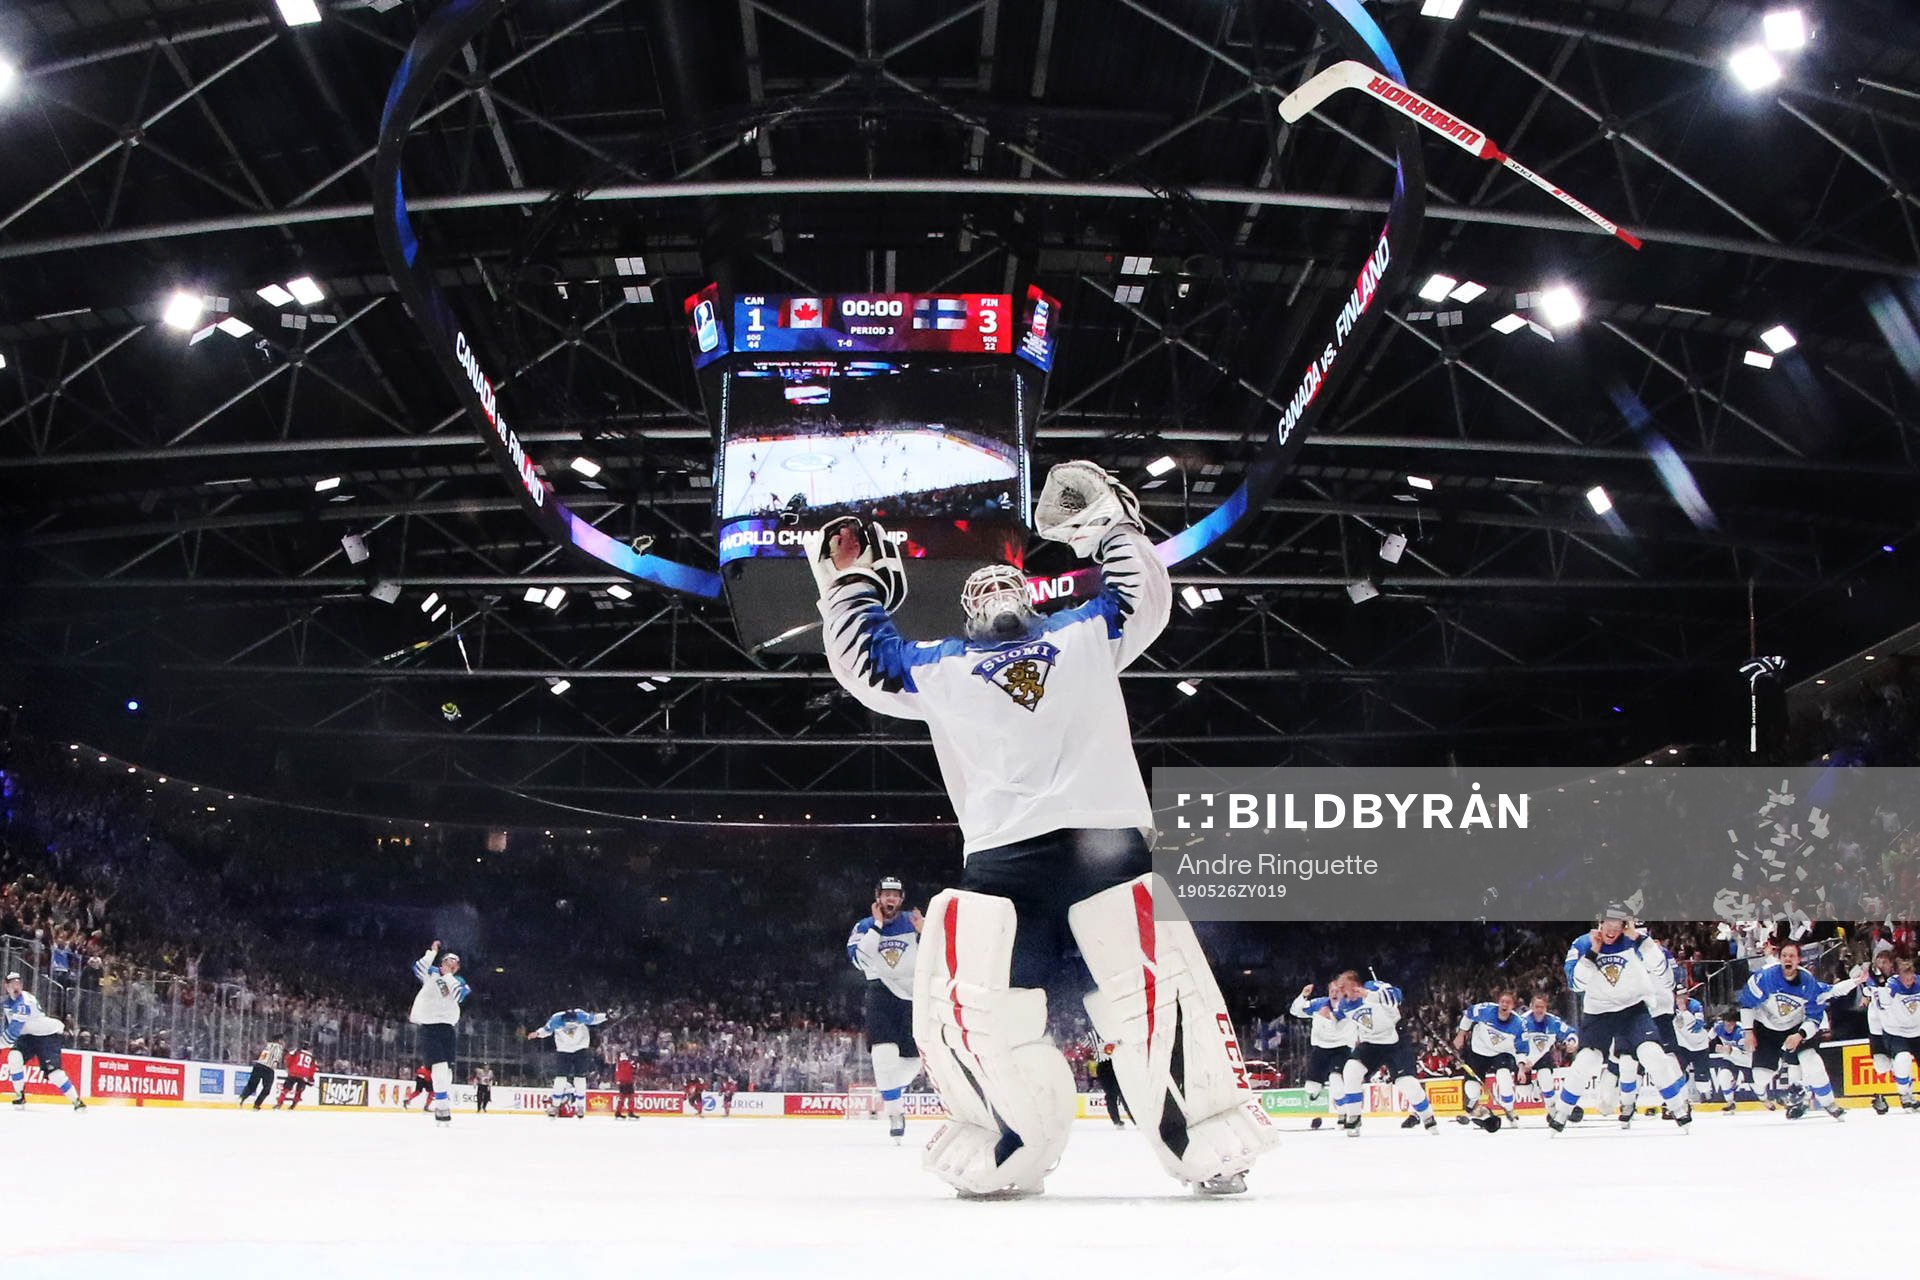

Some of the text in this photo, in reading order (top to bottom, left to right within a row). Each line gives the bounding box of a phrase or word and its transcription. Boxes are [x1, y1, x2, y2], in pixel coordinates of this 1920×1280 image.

[1367, 76, 1480, 146] WARRIOR
[744, 297, 765, 305] CAN
[842, 301, 903, 317] 00:00
[980, 298, 999, 307] FIN
[748, 309, 765, 332] 1
[850, 326, 895, 335] PERIOD 3
[979, 310, 998, 333] 3
[984, 343, 996, 351] 22
[1278, 236, 1390, 445] CANADA vs. FINLAND
[456, 331, 544, 508] CANADA vs. FINLAND
[723, 530, 775, 551] WORLD
[982, 645, 1050, 672] SUOMI
[297, 1053, 312, 1069] 19
[1216, 1013, 1250, 1089] CCM
[98, 1075, 179, 1096] #BRATISLAVA
[1429, 1087, 1459, 1104] PIRELLI
